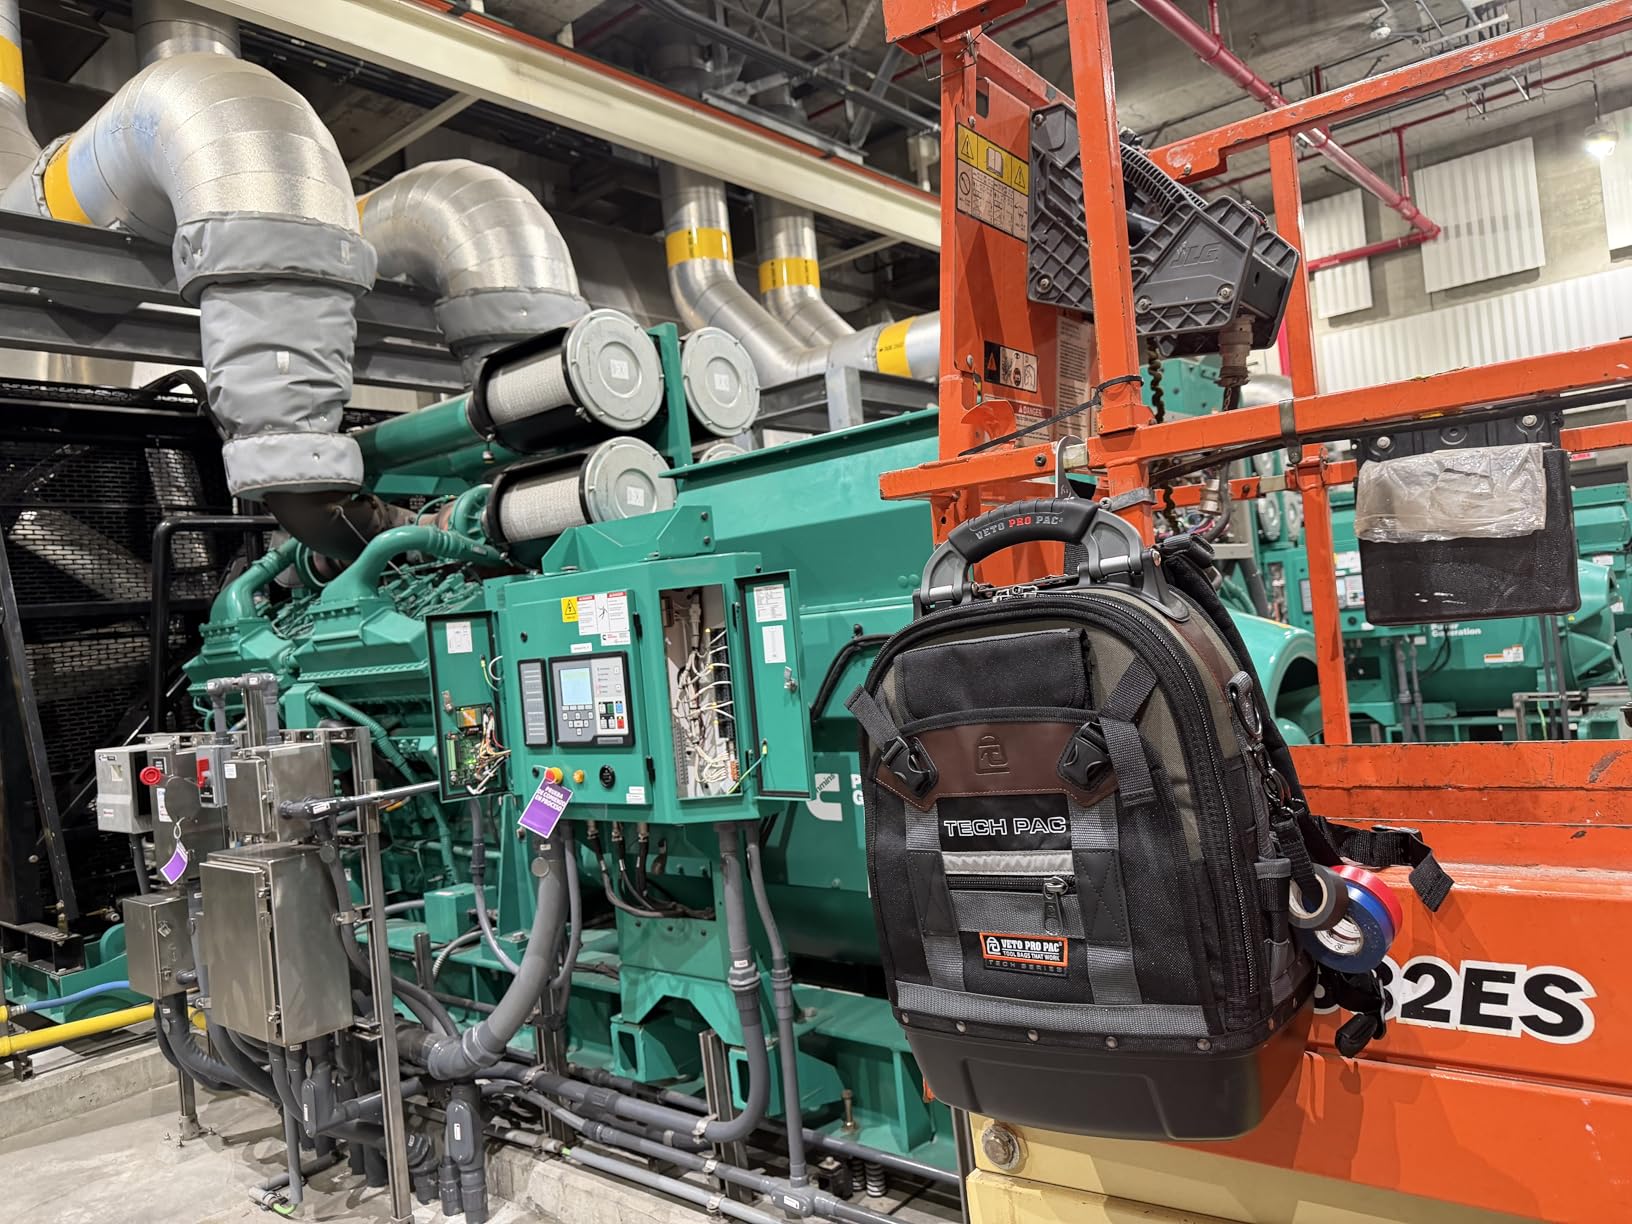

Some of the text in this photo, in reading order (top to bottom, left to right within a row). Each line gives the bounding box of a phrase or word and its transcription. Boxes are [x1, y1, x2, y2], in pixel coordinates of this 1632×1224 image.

[975, 522, 1005, 540] VETO
[1008, 516, 1033, 528] PRO
[943, 816, 1067, 837] TECH PAC
[1000, 939, 1023, 950] VETO
[1024, 940, 1042, 951] PRO
[1002, 950, 1017, 958] TOOL
[1017, 951, 1031, 959] BAGS
[988, 959, 1063, 973] TECH SERIES
